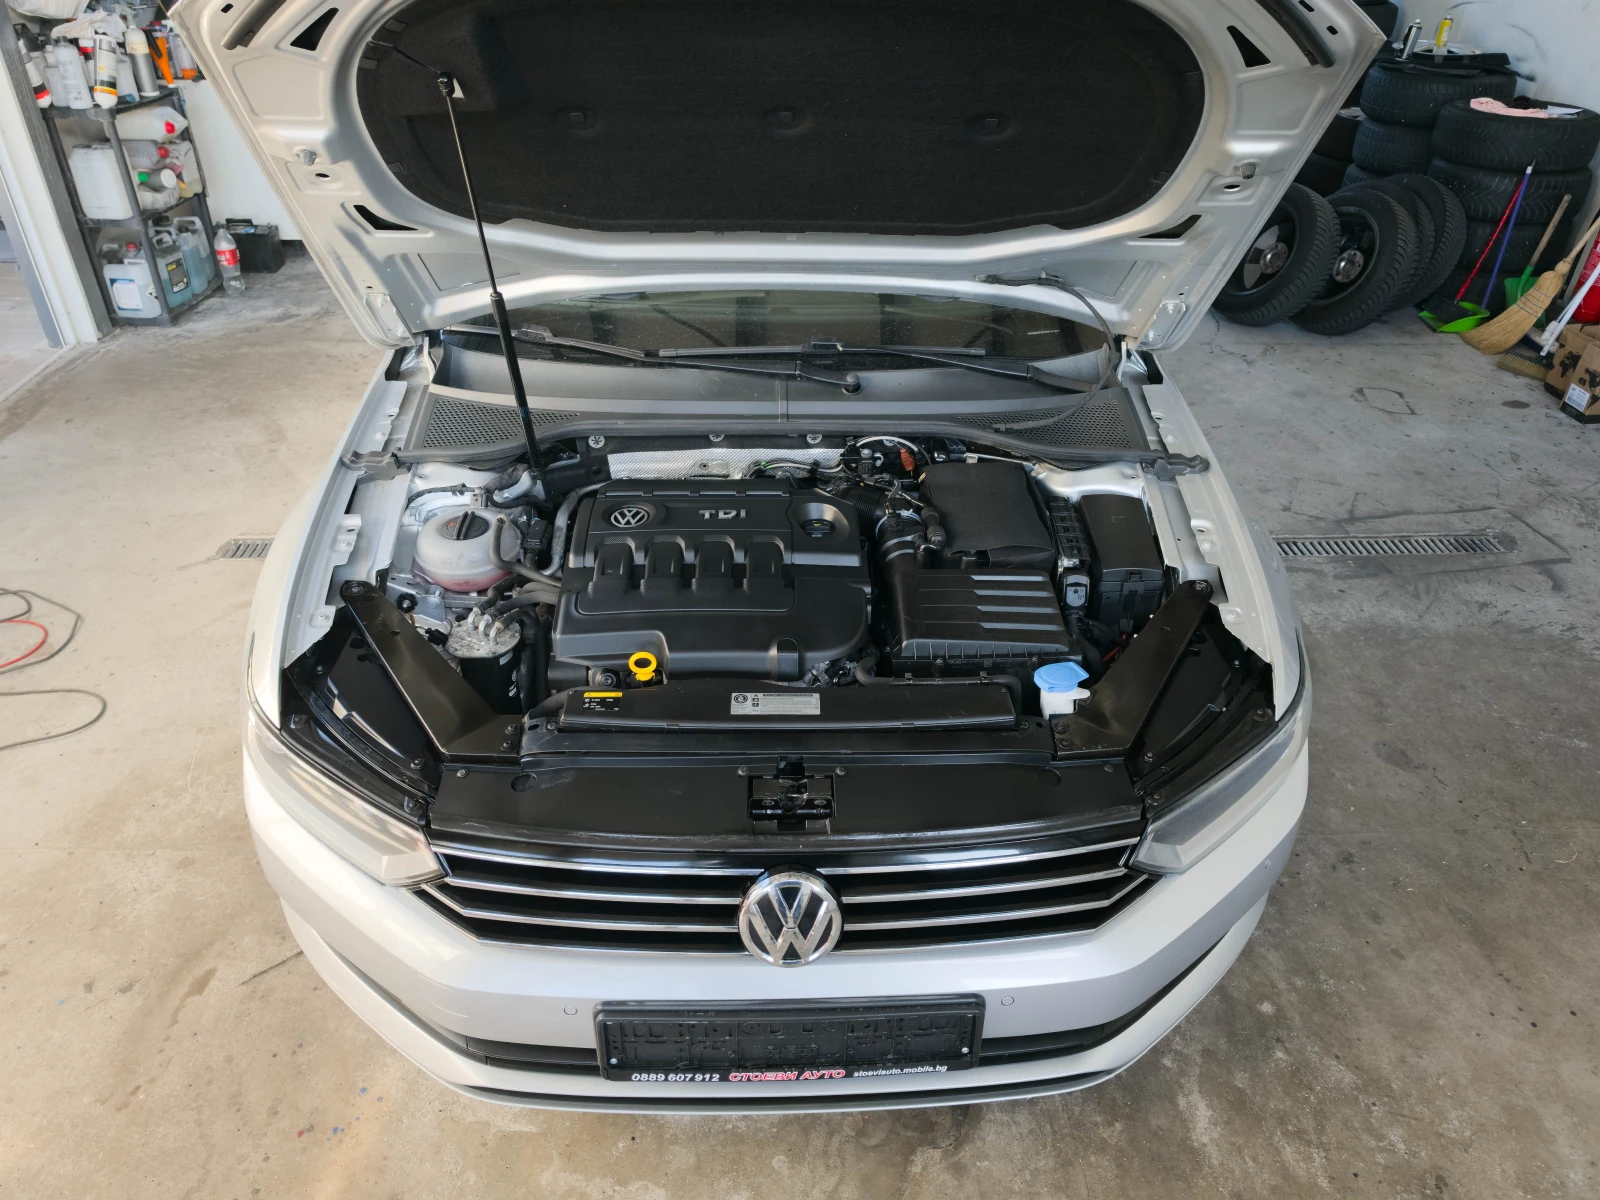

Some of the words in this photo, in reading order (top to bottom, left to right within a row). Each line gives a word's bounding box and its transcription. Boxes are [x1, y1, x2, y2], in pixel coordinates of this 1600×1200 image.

[698, 508, 747, 520] TDI
[631, 1073, 666, 1082] 0889
[667, 1073, 694, 1082] 607
[694, 1073, 720, 1082] 912
[728, 1071, 799, 1082] СТОЕВИ
[799, 1069, 846, 1081] АУТО
[853, 1064, 948, 1078] stoeviauto.mobile.bg
